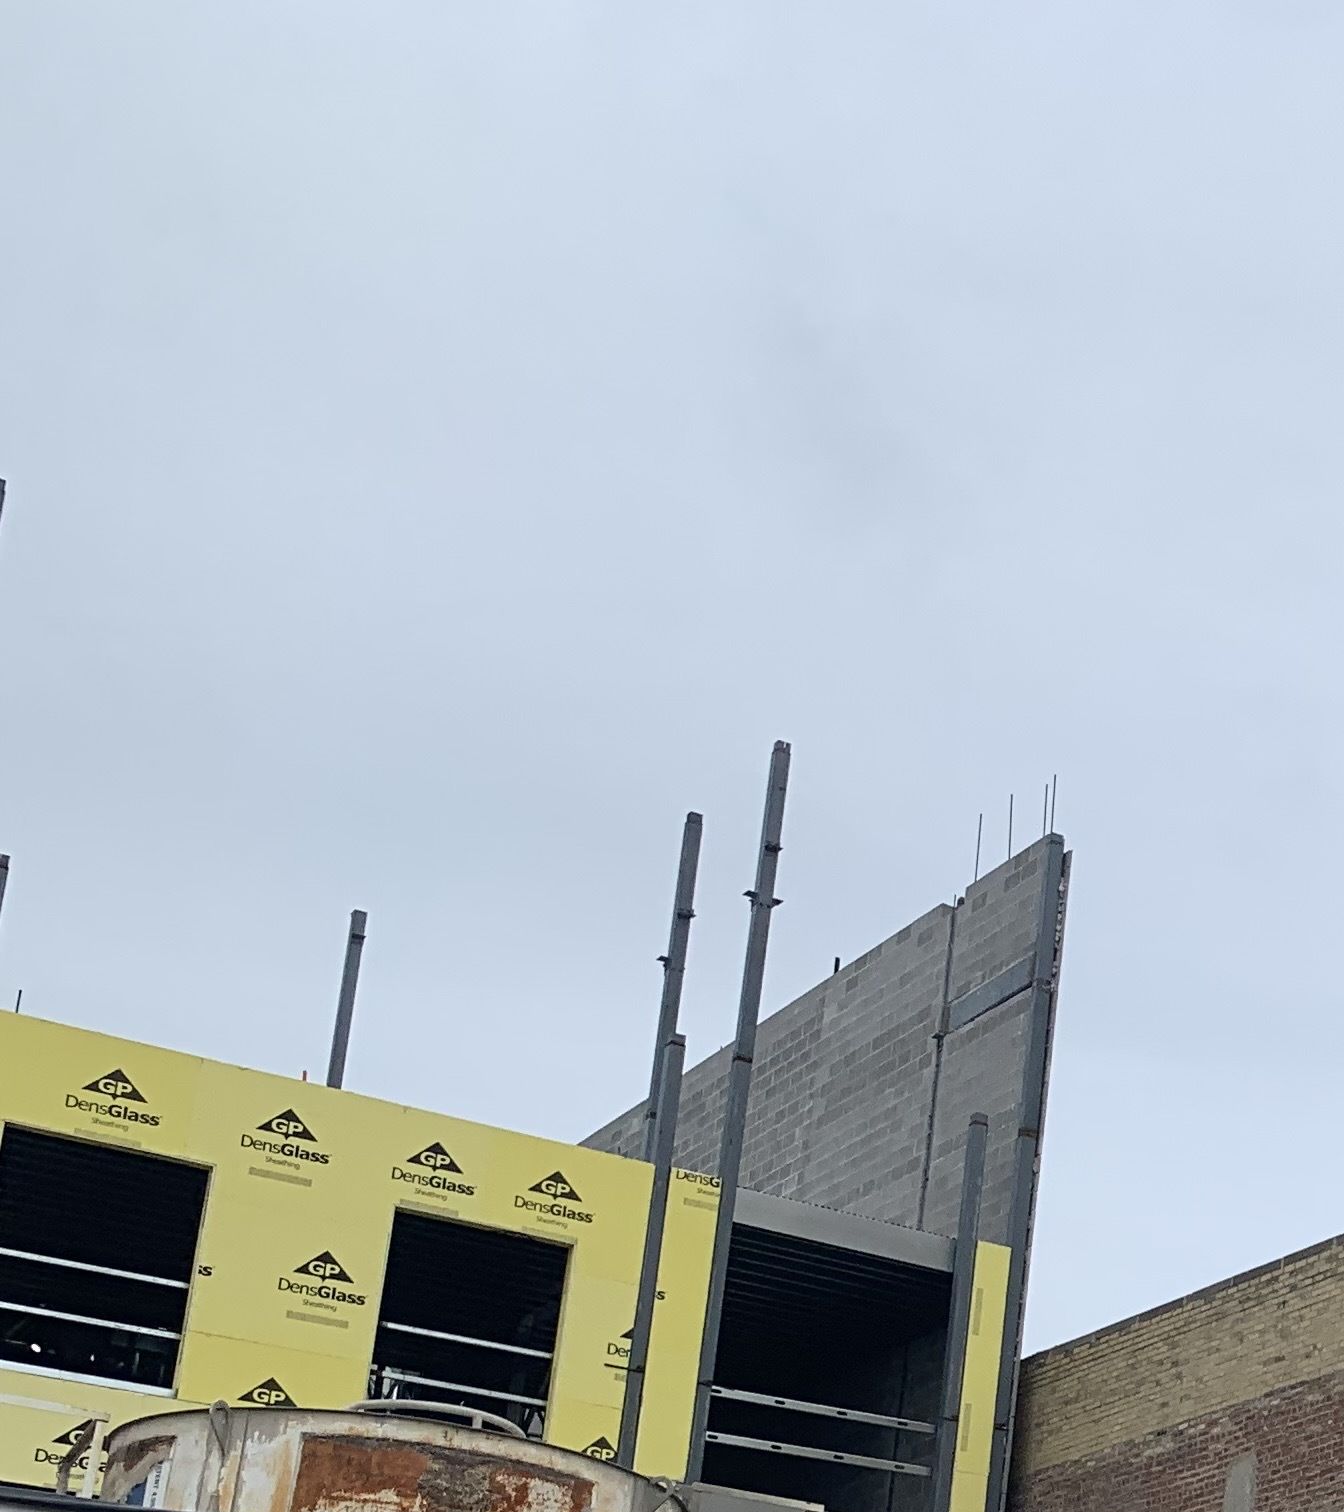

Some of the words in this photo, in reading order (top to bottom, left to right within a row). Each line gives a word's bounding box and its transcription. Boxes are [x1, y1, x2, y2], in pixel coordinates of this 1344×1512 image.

[97, 1078, 133, 1096] GP
[65, 1094, 161, 1127] DensGlass
[270, 1118, 304, 1136] GP
[240, 1134, 330, 1165] DensGlass
[419, 1151, 451, 1167] GP
[391, 1167, 475, 1196] DensGlass
[540, 1180, 571, 1196] GP
[514, 1195, 594, 1223] DensGlass
[307, 1260, 341, 1277] GP
[277, 1277, 367, 1306] DensGlass
[252, 1388, 287, 1405] GP
[586, 1445, 616, 1460] GP
